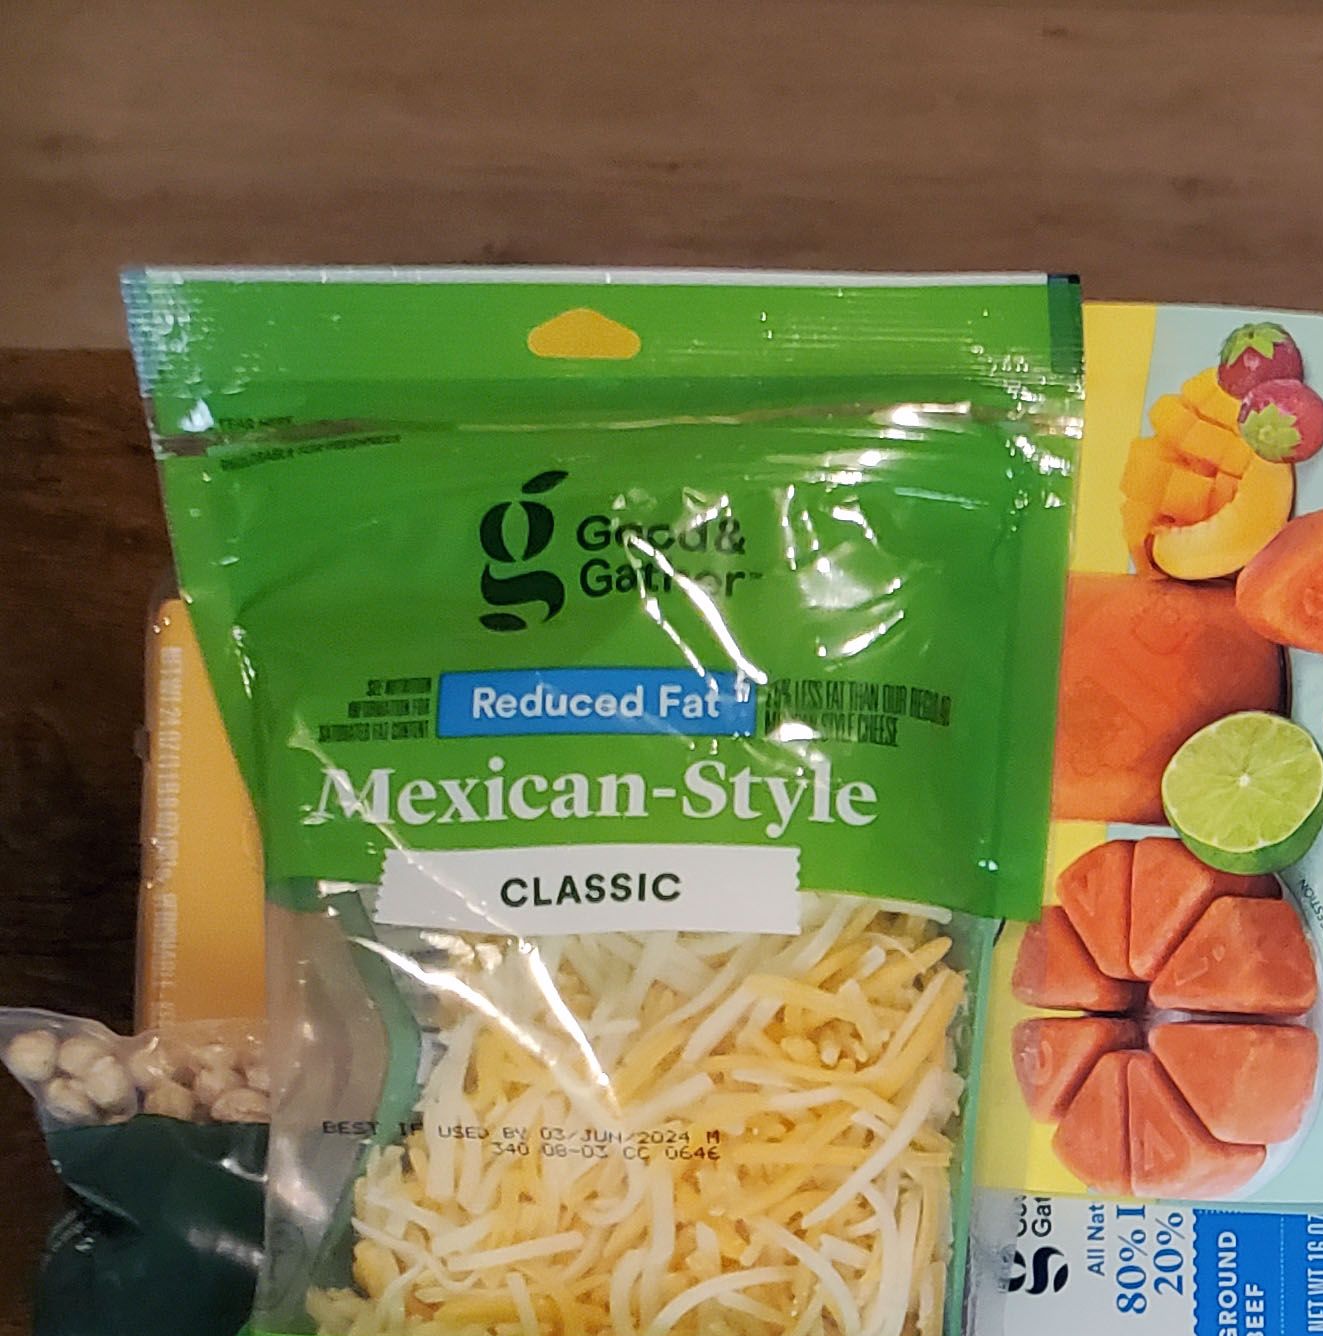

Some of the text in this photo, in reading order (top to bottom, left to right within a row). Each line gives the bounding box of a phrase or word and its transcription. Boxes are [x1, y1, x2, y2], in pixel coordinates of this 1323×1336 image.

[472, 685, 647, 720] Reduced
[658, 685, 721, 720] Fat
[309, 757, 878, 839] Mexican-Style
[500, 872, 681, 908] CLASSIC
[321, 1120, 377, 1135] BEST
[1115, 1229, 1148, 1315] 80%
